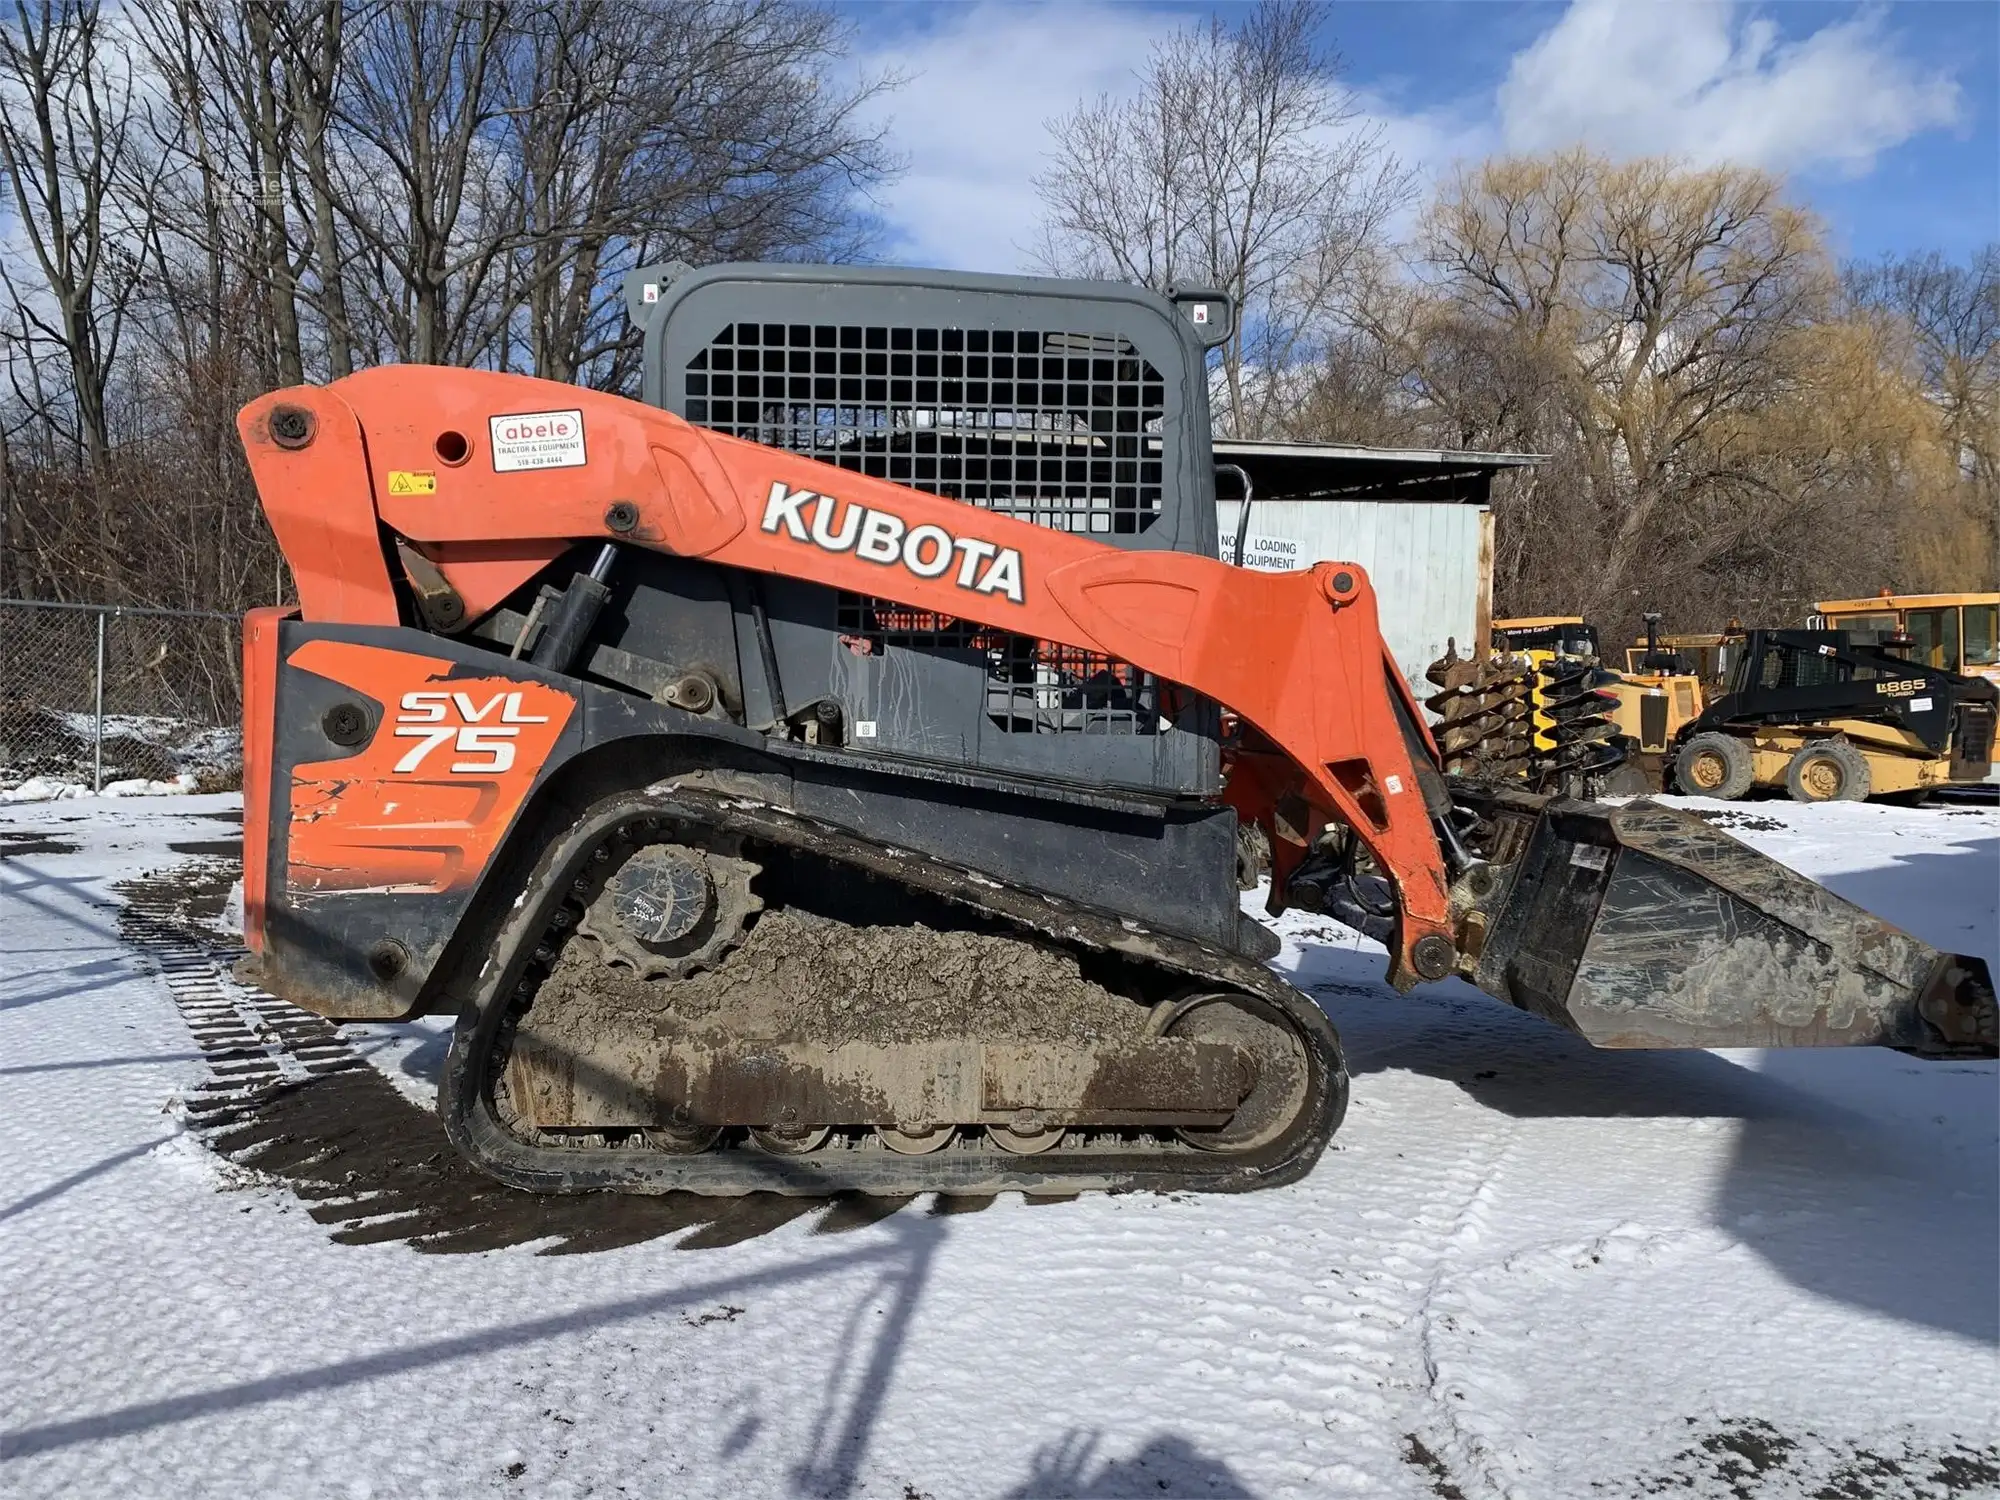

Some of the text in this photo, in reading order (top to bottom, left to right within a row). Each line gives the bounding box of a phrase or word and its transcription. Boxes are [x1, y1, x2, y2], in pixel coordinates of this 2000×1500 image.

[505, 421, 568, 440] abele
[497, 445, 530, 455] TRACTOR
[538, 441, 580, 452] EQUIPMENT
[760, 481, 1024, 603] KUBOTA
[1221, 535, 1297, 554] NO LOADING
[1242, 553, 1296, 569] EQUIPMENT
[1876, 679, 1926, 694] LX865
[1887, 690, 1915, 698] TURBO
[396, 692, 549, 722] SVL
[392, 727, 520, 773] 75
